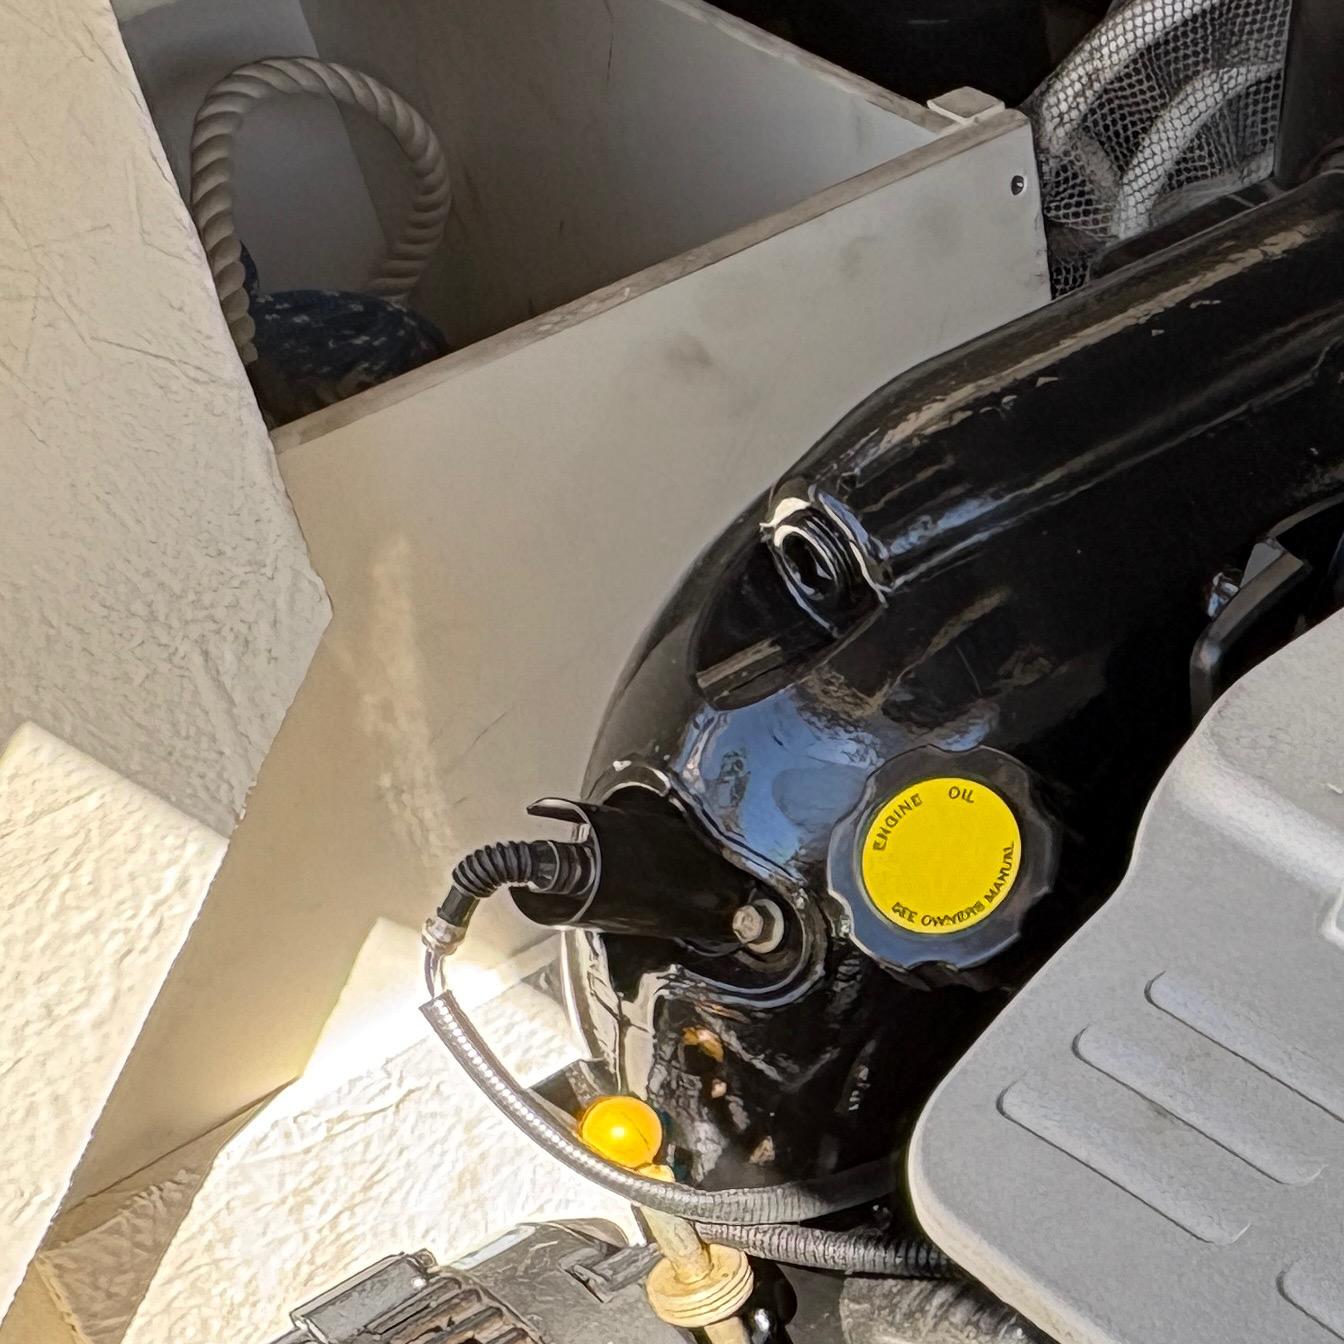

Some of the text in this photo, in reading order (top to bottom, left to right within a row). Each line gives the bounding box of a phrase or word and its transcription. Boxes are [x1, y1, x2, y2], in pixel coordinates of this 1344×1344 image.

[872, 785, 975, 851] ENGINE OIL
[891, 902, 917, 924] SEE
[984, 840, 1015, 905] MANUAL
